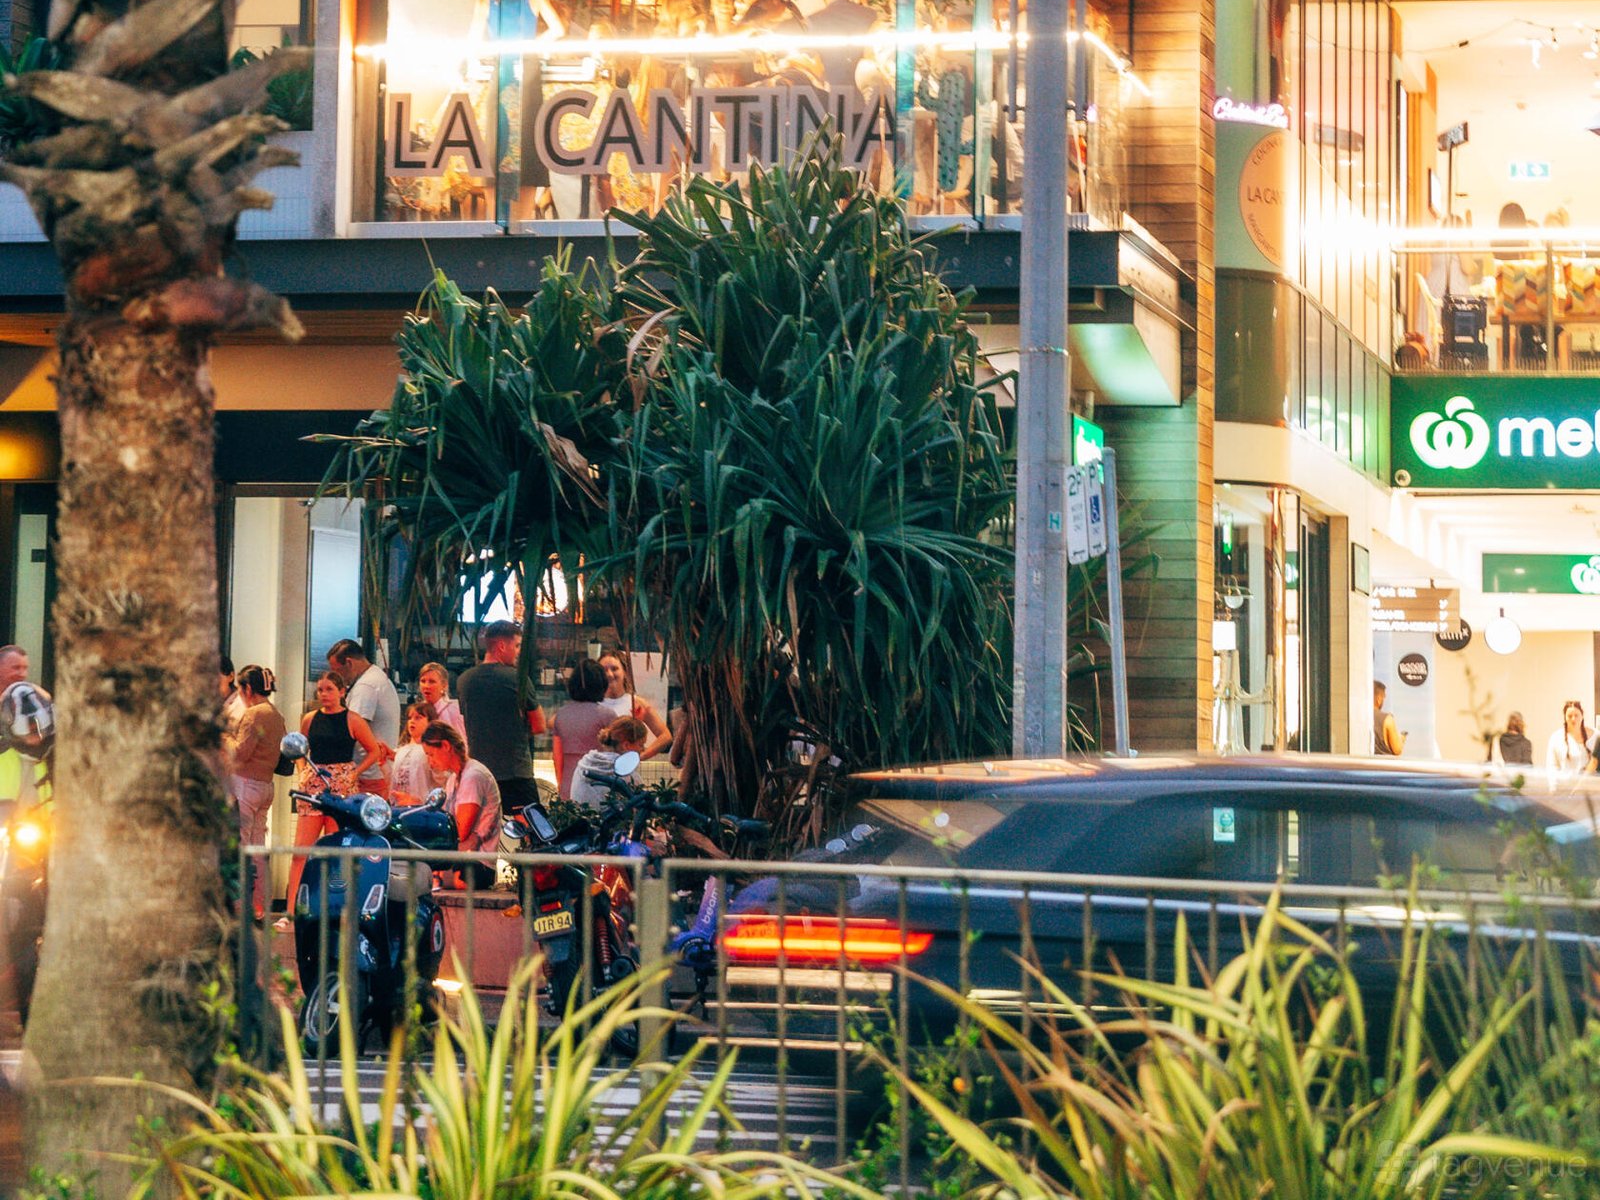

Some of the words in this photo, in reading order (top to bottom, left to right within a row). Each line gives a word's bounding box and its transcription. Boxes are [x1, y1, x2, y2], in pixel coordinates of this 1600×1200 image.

[392, 98, 484, 170] LA
[542, 92, 899, 169] CANTINA
[1049, 512, 1061, 530] H
[702, 887, 719, 925] beam
